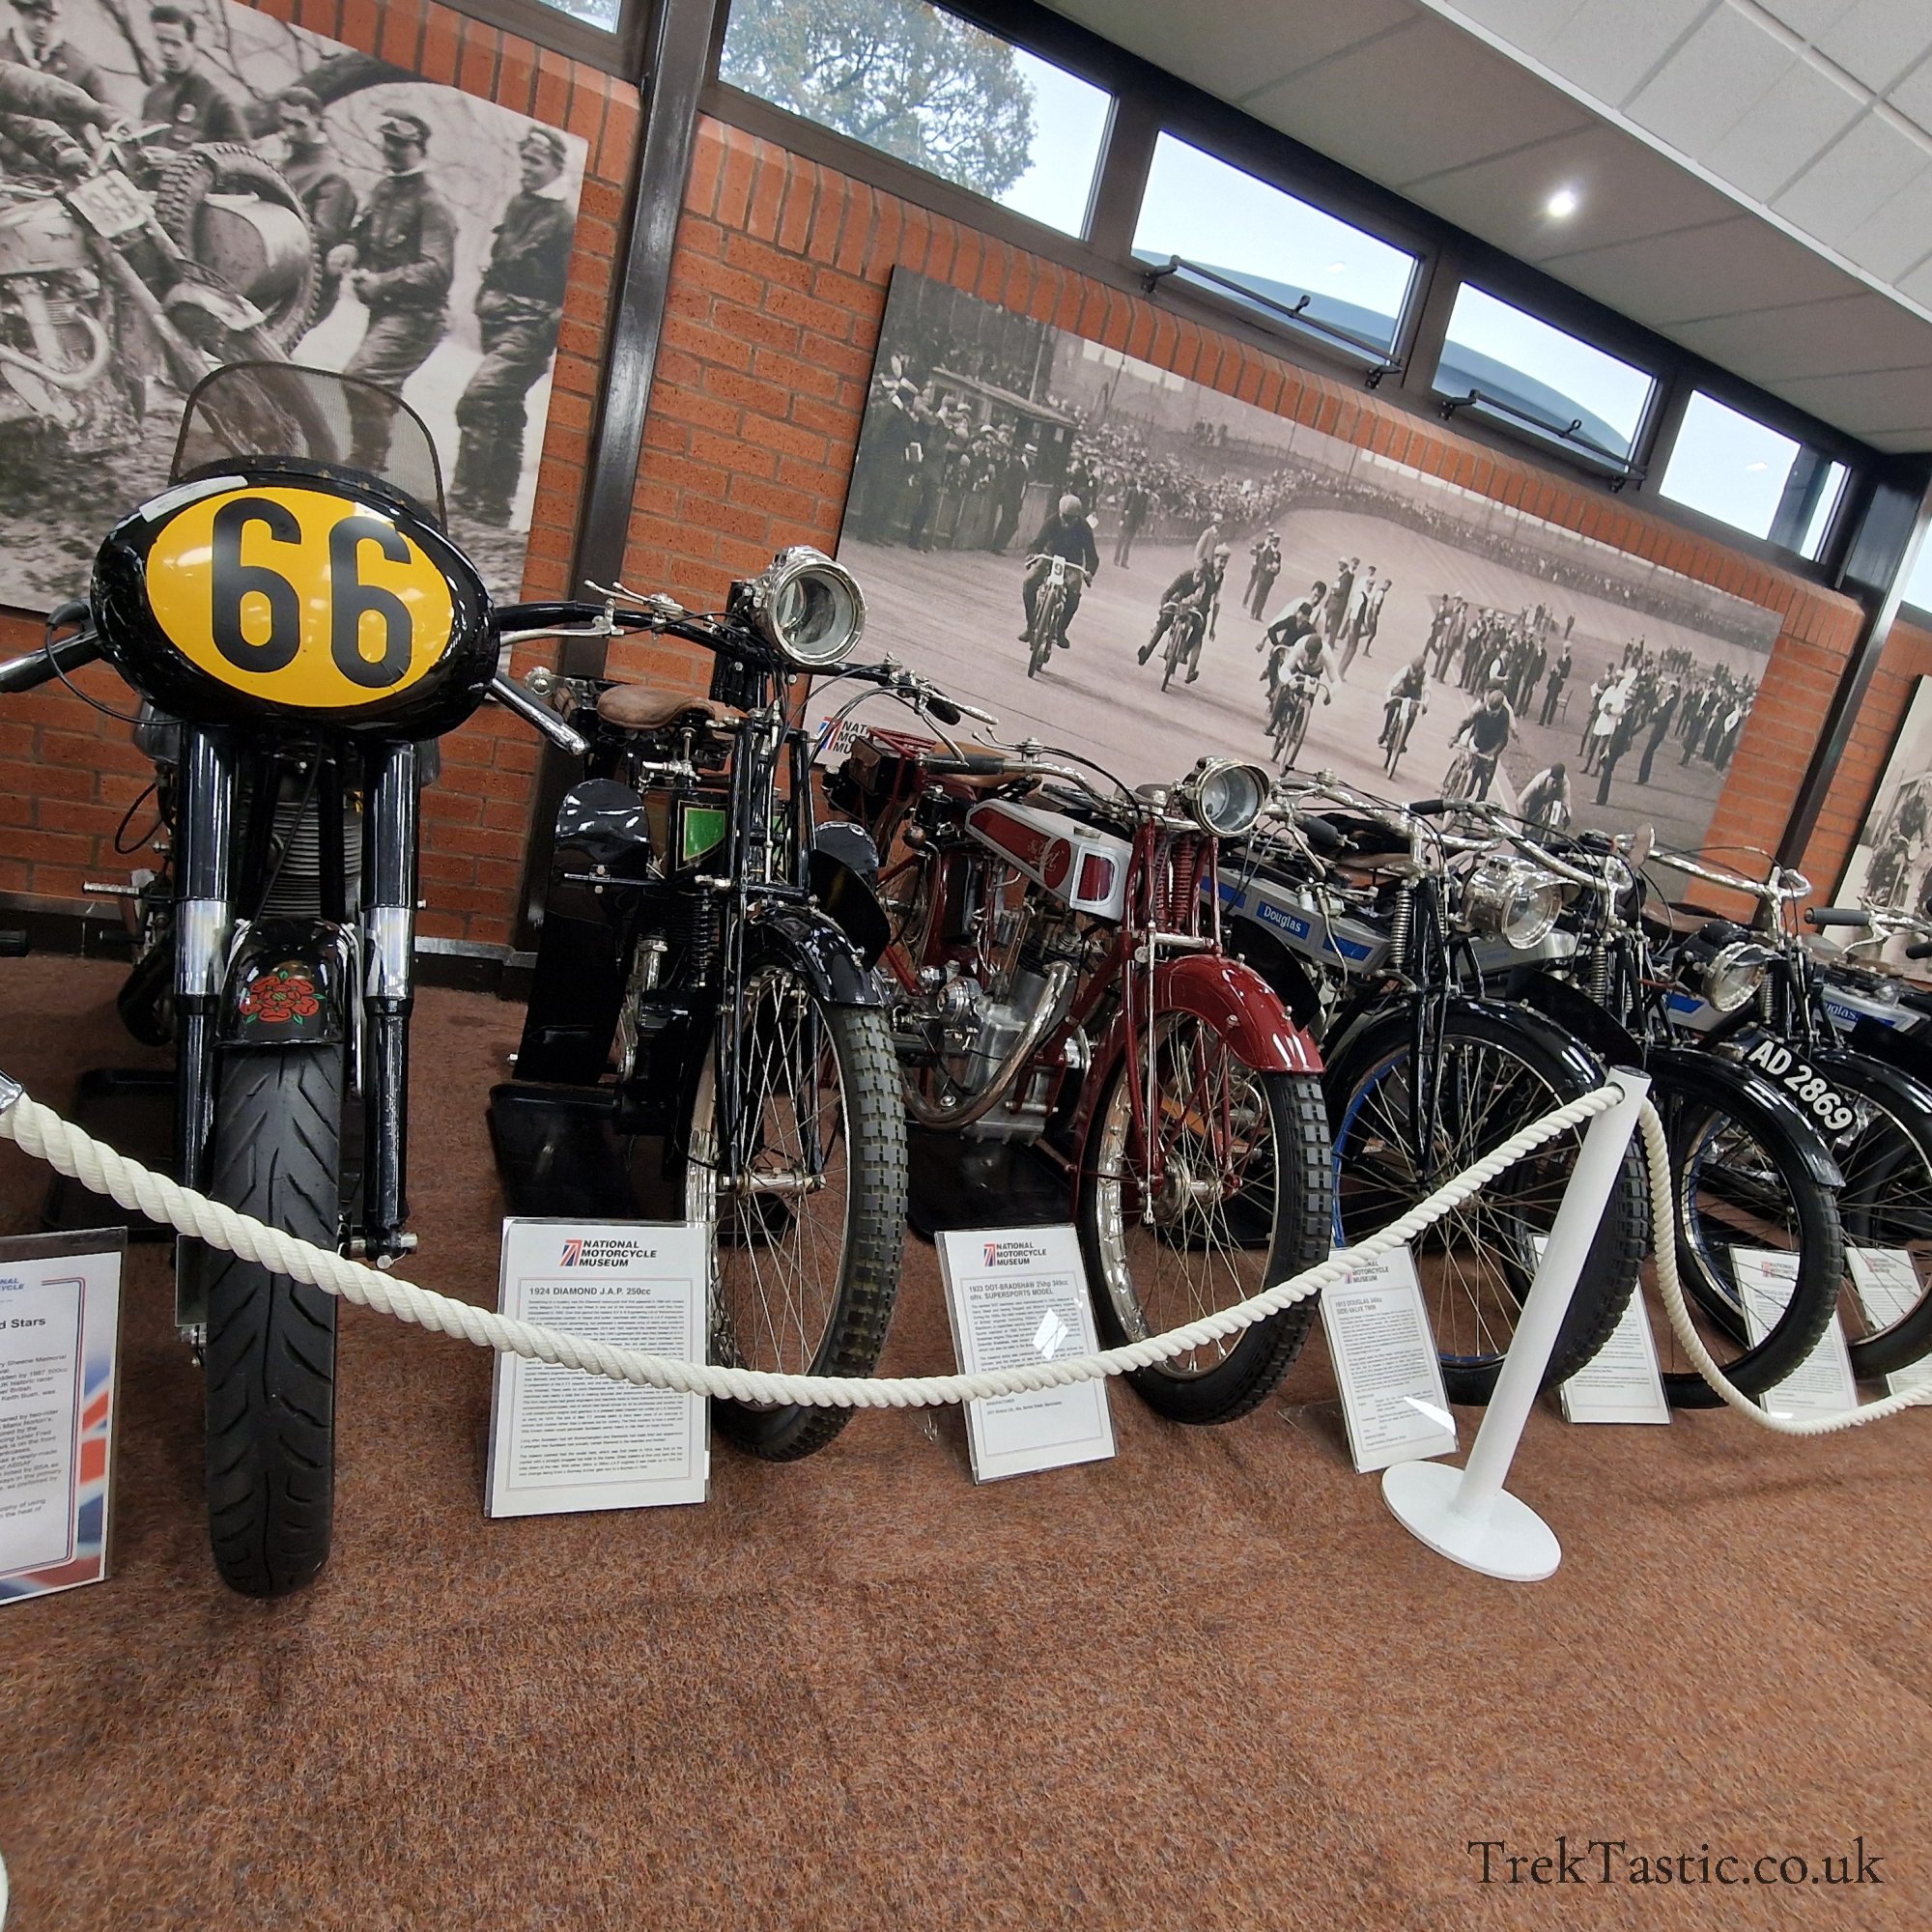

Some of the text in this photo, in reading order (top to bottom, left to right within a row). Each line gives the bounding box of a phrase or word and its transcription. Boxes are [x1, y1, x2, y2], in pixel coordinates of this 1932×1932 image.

[1054, 563, 1064, 576] 9
[212, 497, 413, 689] 66
[1264, 905, 1302, 933] Douglas
[1748, 1039, 1853, 1130] AD 2869
[582, 1239, 639, 1249] NATIONAL
[581, 1249, 658, 1258] MOTORCYCLE
[996, 1249, 1046, 1258] MOTORCYCLE
[579, 1258, 630, 1267] MUSEUM
[529, 1287, 652, 1295] 1924 DIAMOND J.A.P. 250cc
[984, 1290, 1032, 1299] SUPERSPORTS
[11, 1319, 45, 1328] Stars
